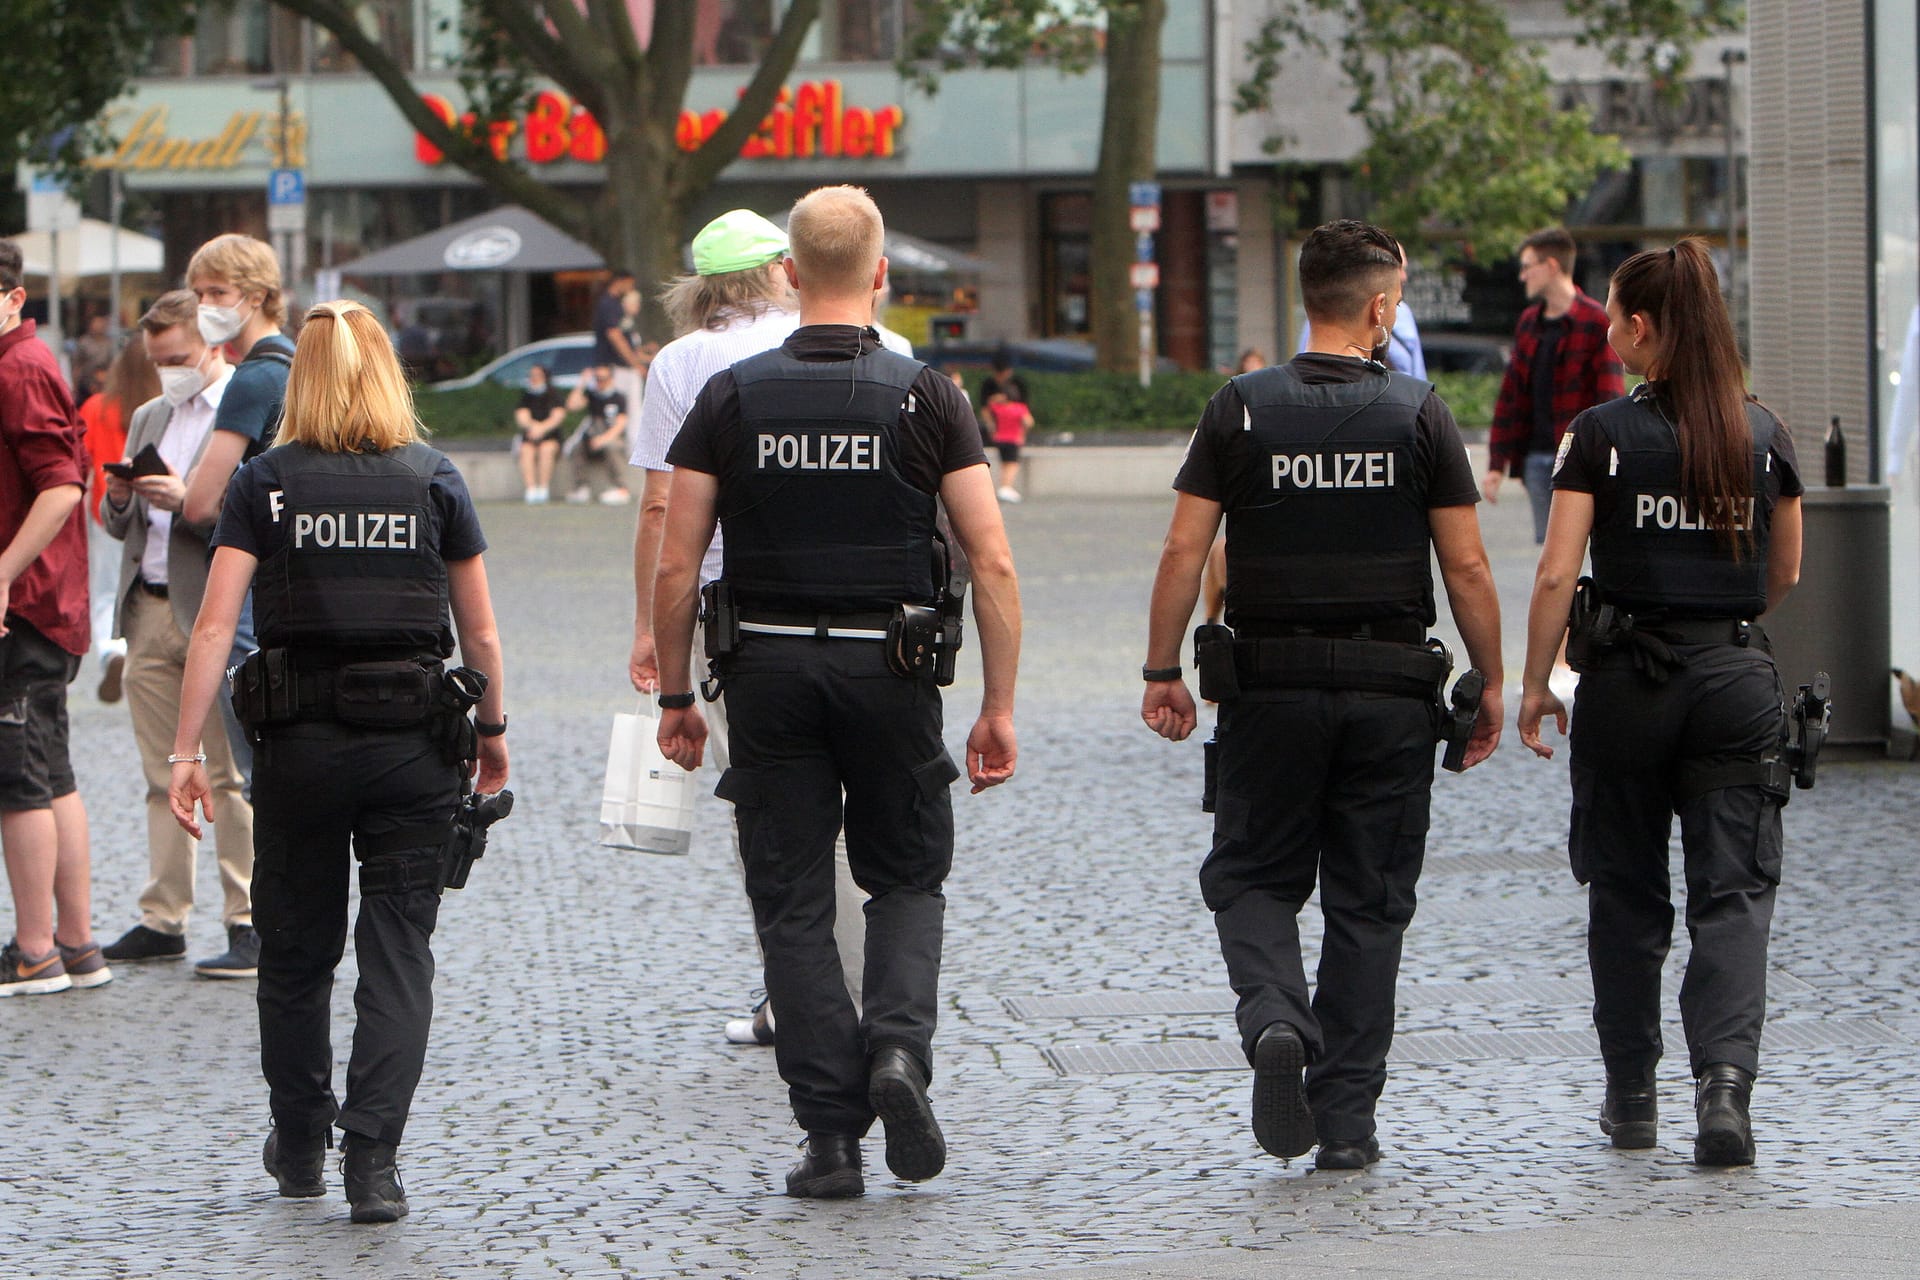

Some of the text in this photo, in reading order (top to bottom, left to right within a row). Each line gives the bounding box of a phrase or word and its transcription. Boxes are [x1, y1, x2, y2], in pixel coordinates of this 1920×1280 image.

[415, 93, 517, 165] Dr
[758, 434, 881, 470] POLIZEI
[1271, 452, 1395, 489] POLIZEI
[295, 513, 417, 550] POLIZEI
